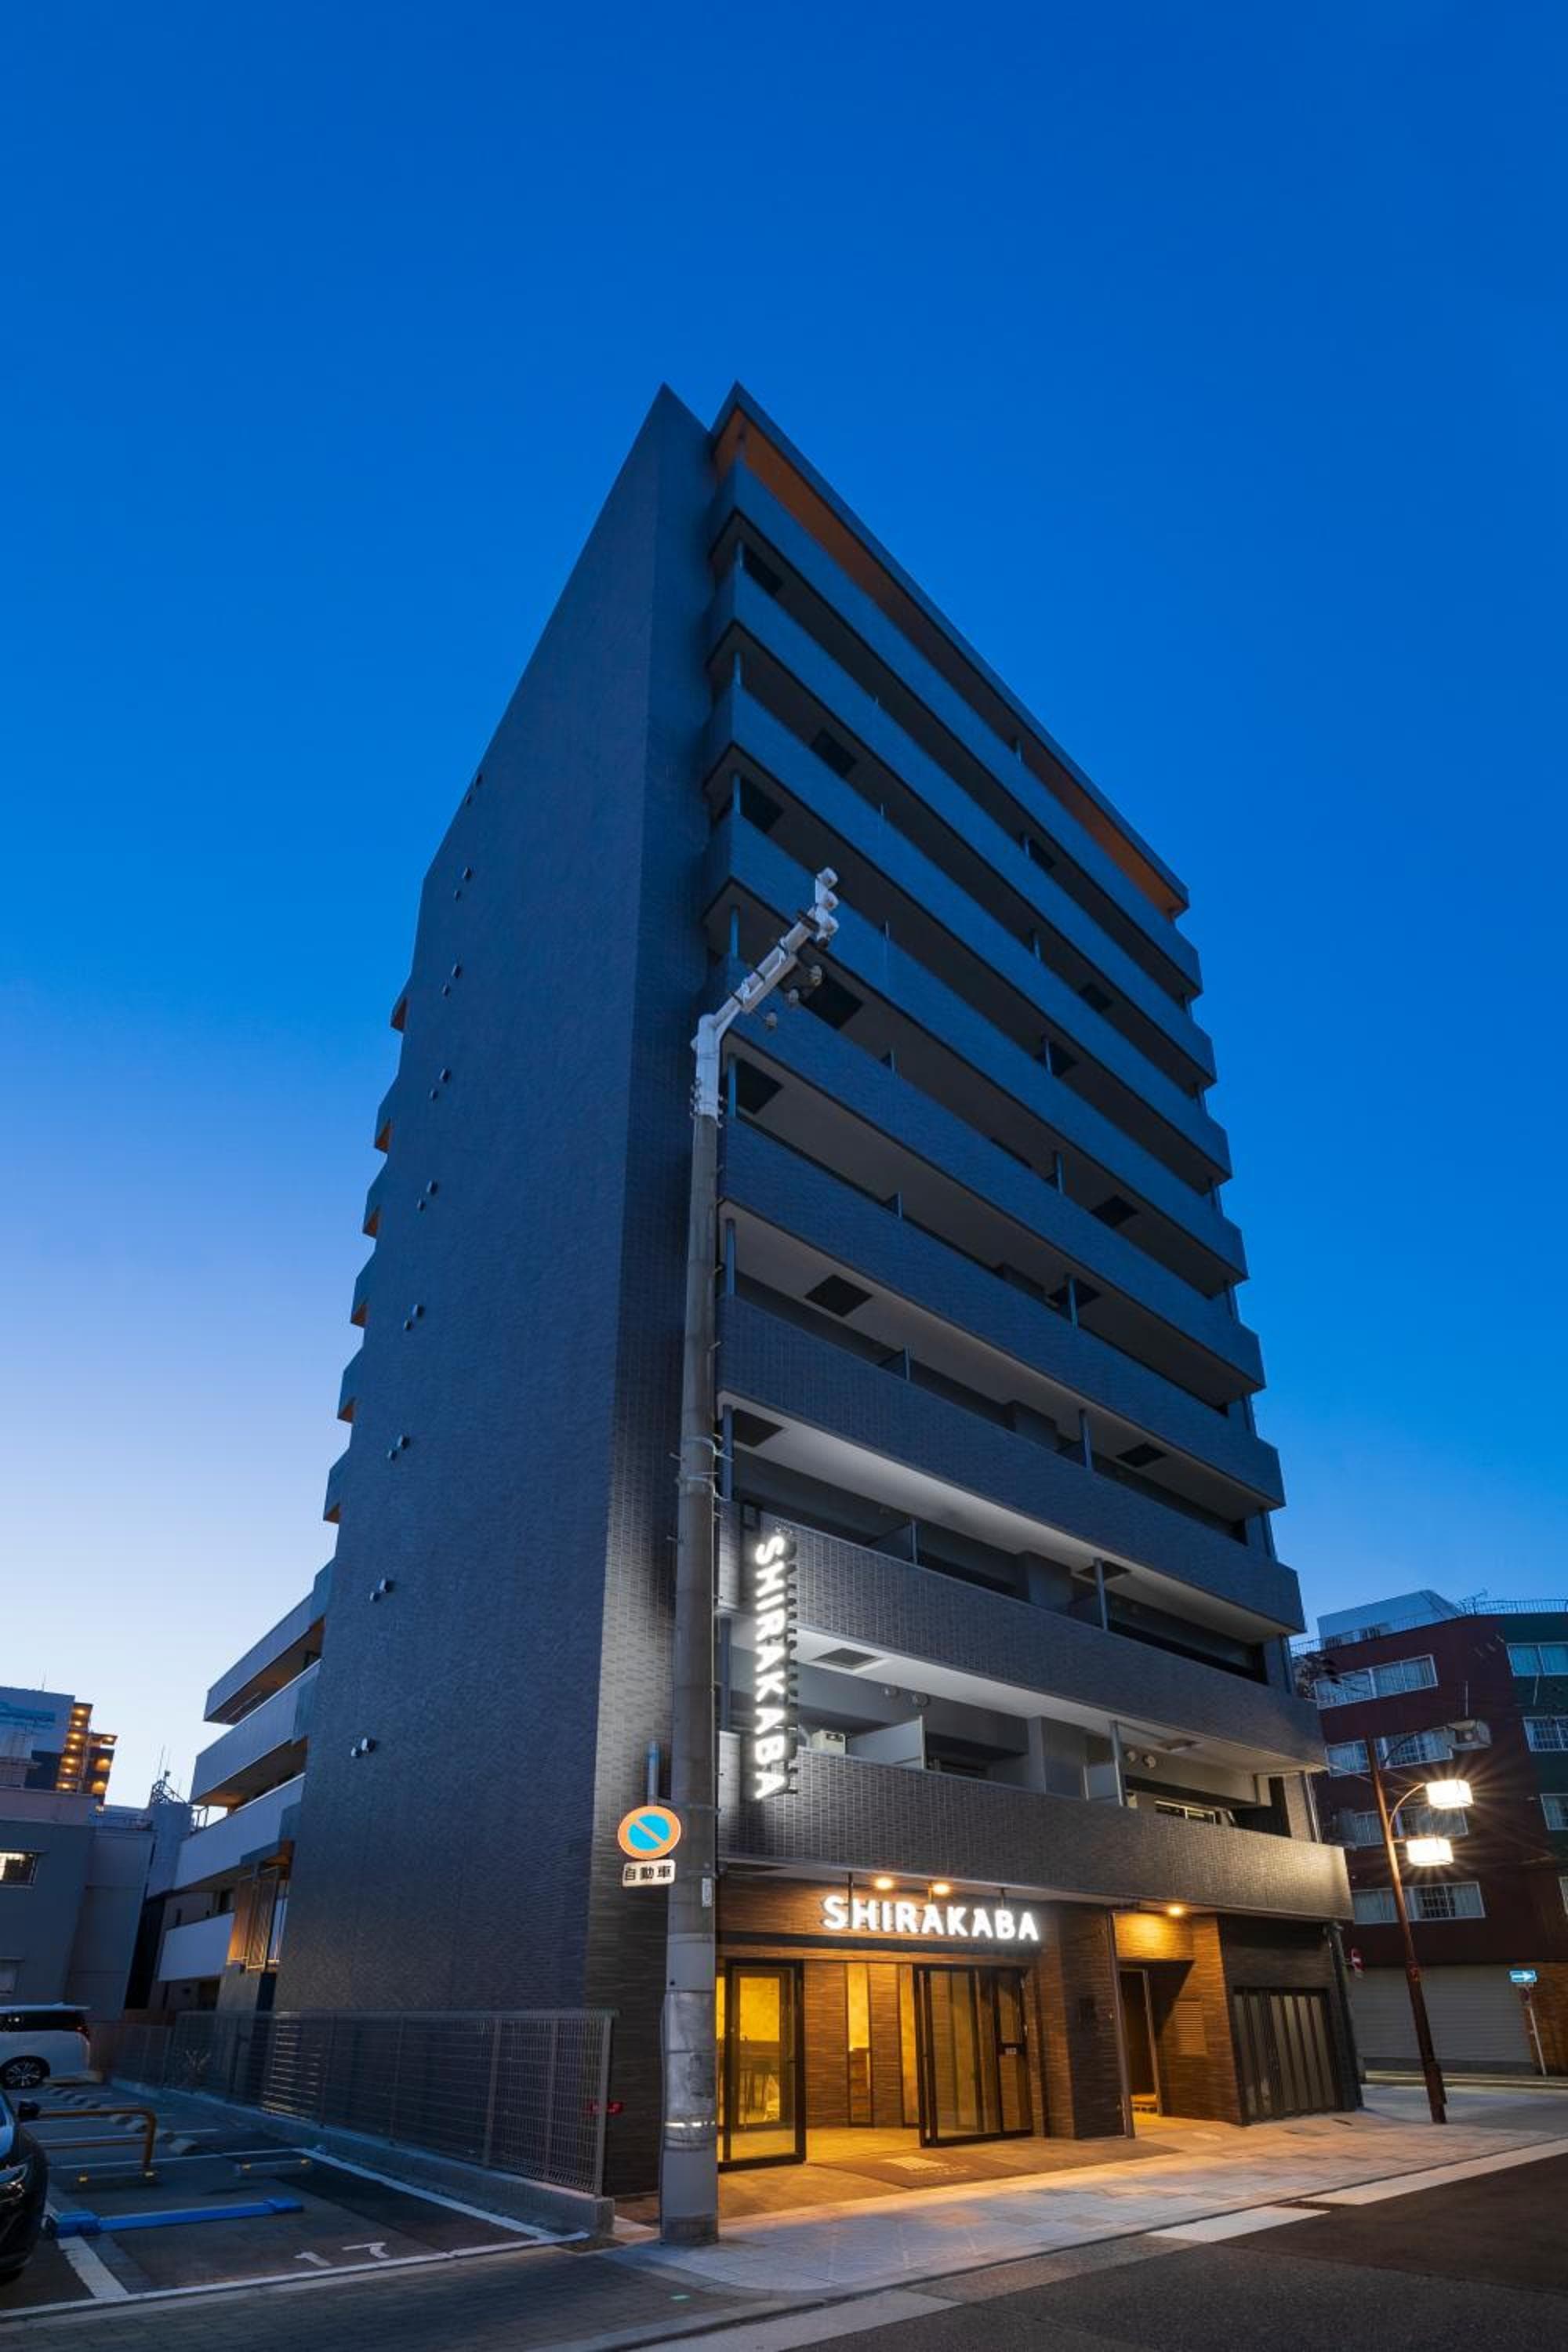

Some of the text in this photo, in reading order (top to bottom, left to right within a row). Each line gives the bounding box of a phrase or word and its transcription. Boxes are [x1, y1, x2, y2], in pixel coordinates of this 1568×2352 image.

[754, 1535, 786, 1799] SHIRAKABA
[624, 1865, 672, 1881] 自動車
[823, 1895, 1040, 1941] SHIRAKABA
